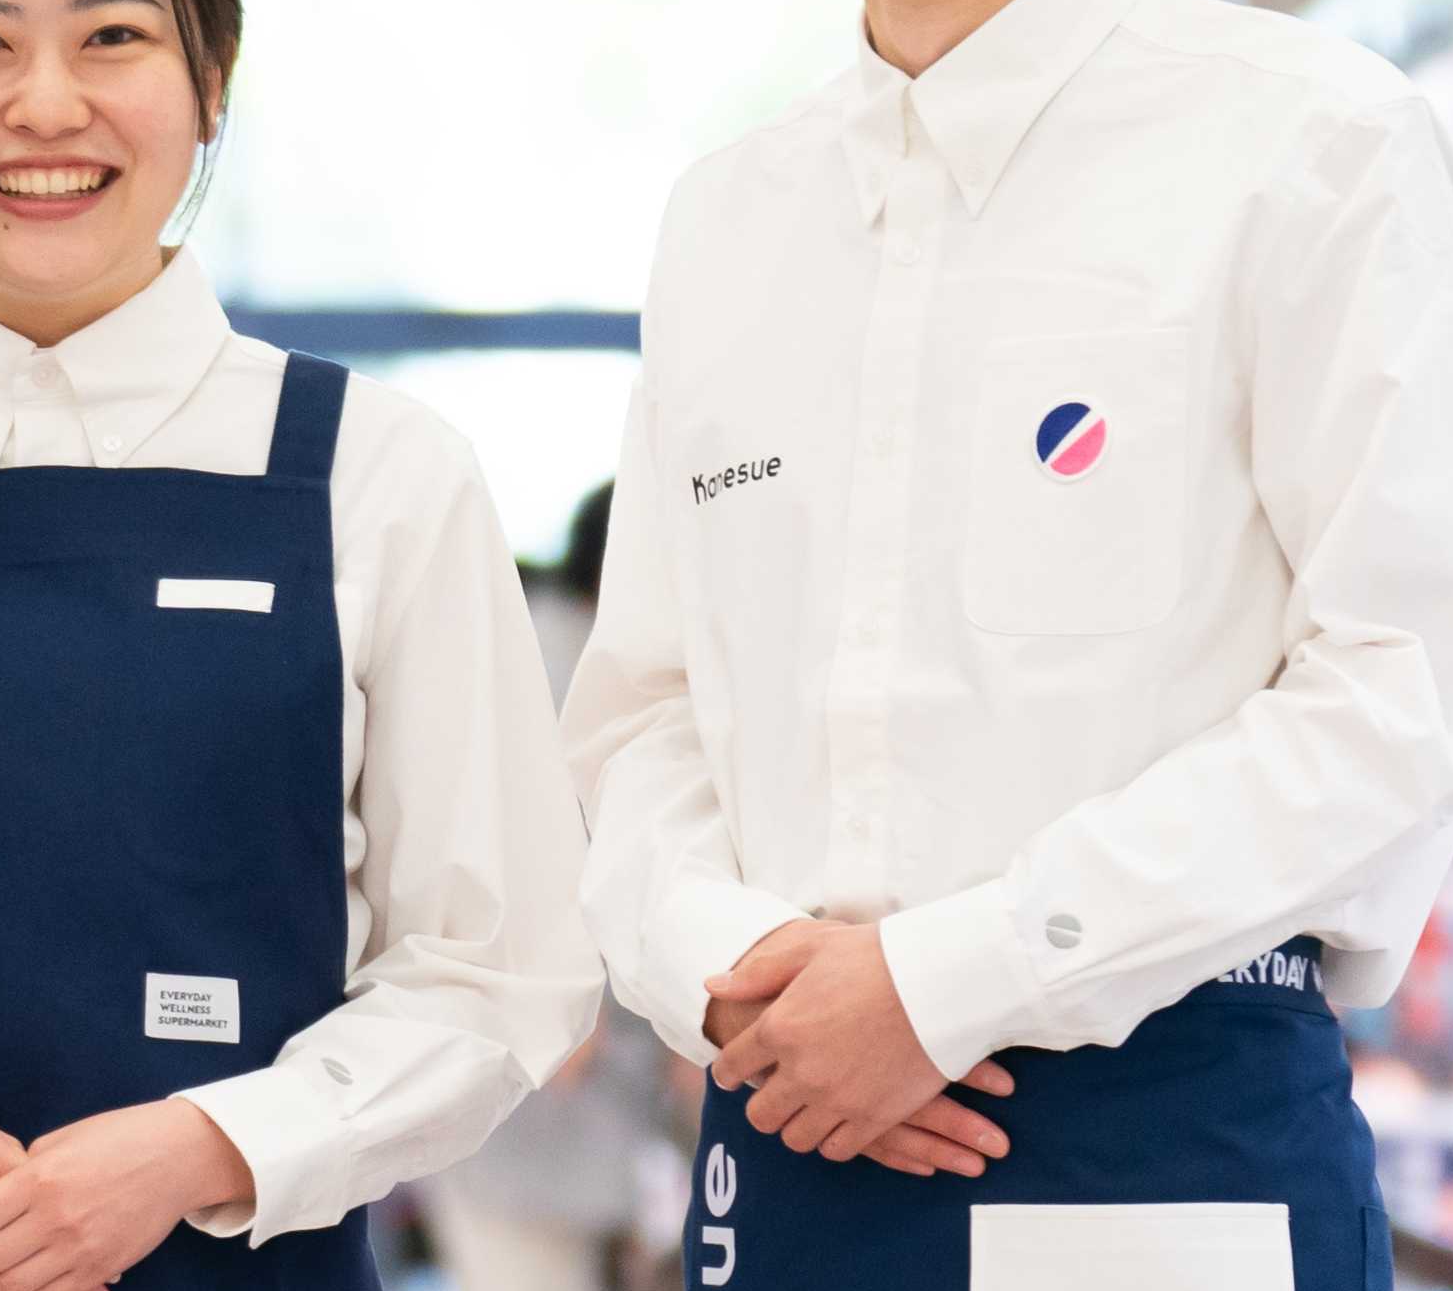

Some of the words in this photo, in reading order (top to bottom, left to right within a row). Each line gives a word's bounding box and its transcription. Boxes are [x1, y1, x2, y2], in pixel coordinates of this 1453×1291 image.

[159, 990, 212, 1002] EVERYDAY
[159, 1003, 212, 1015] WELLNESS
[157, 1015, 228, 1029] SUPERMARKET
